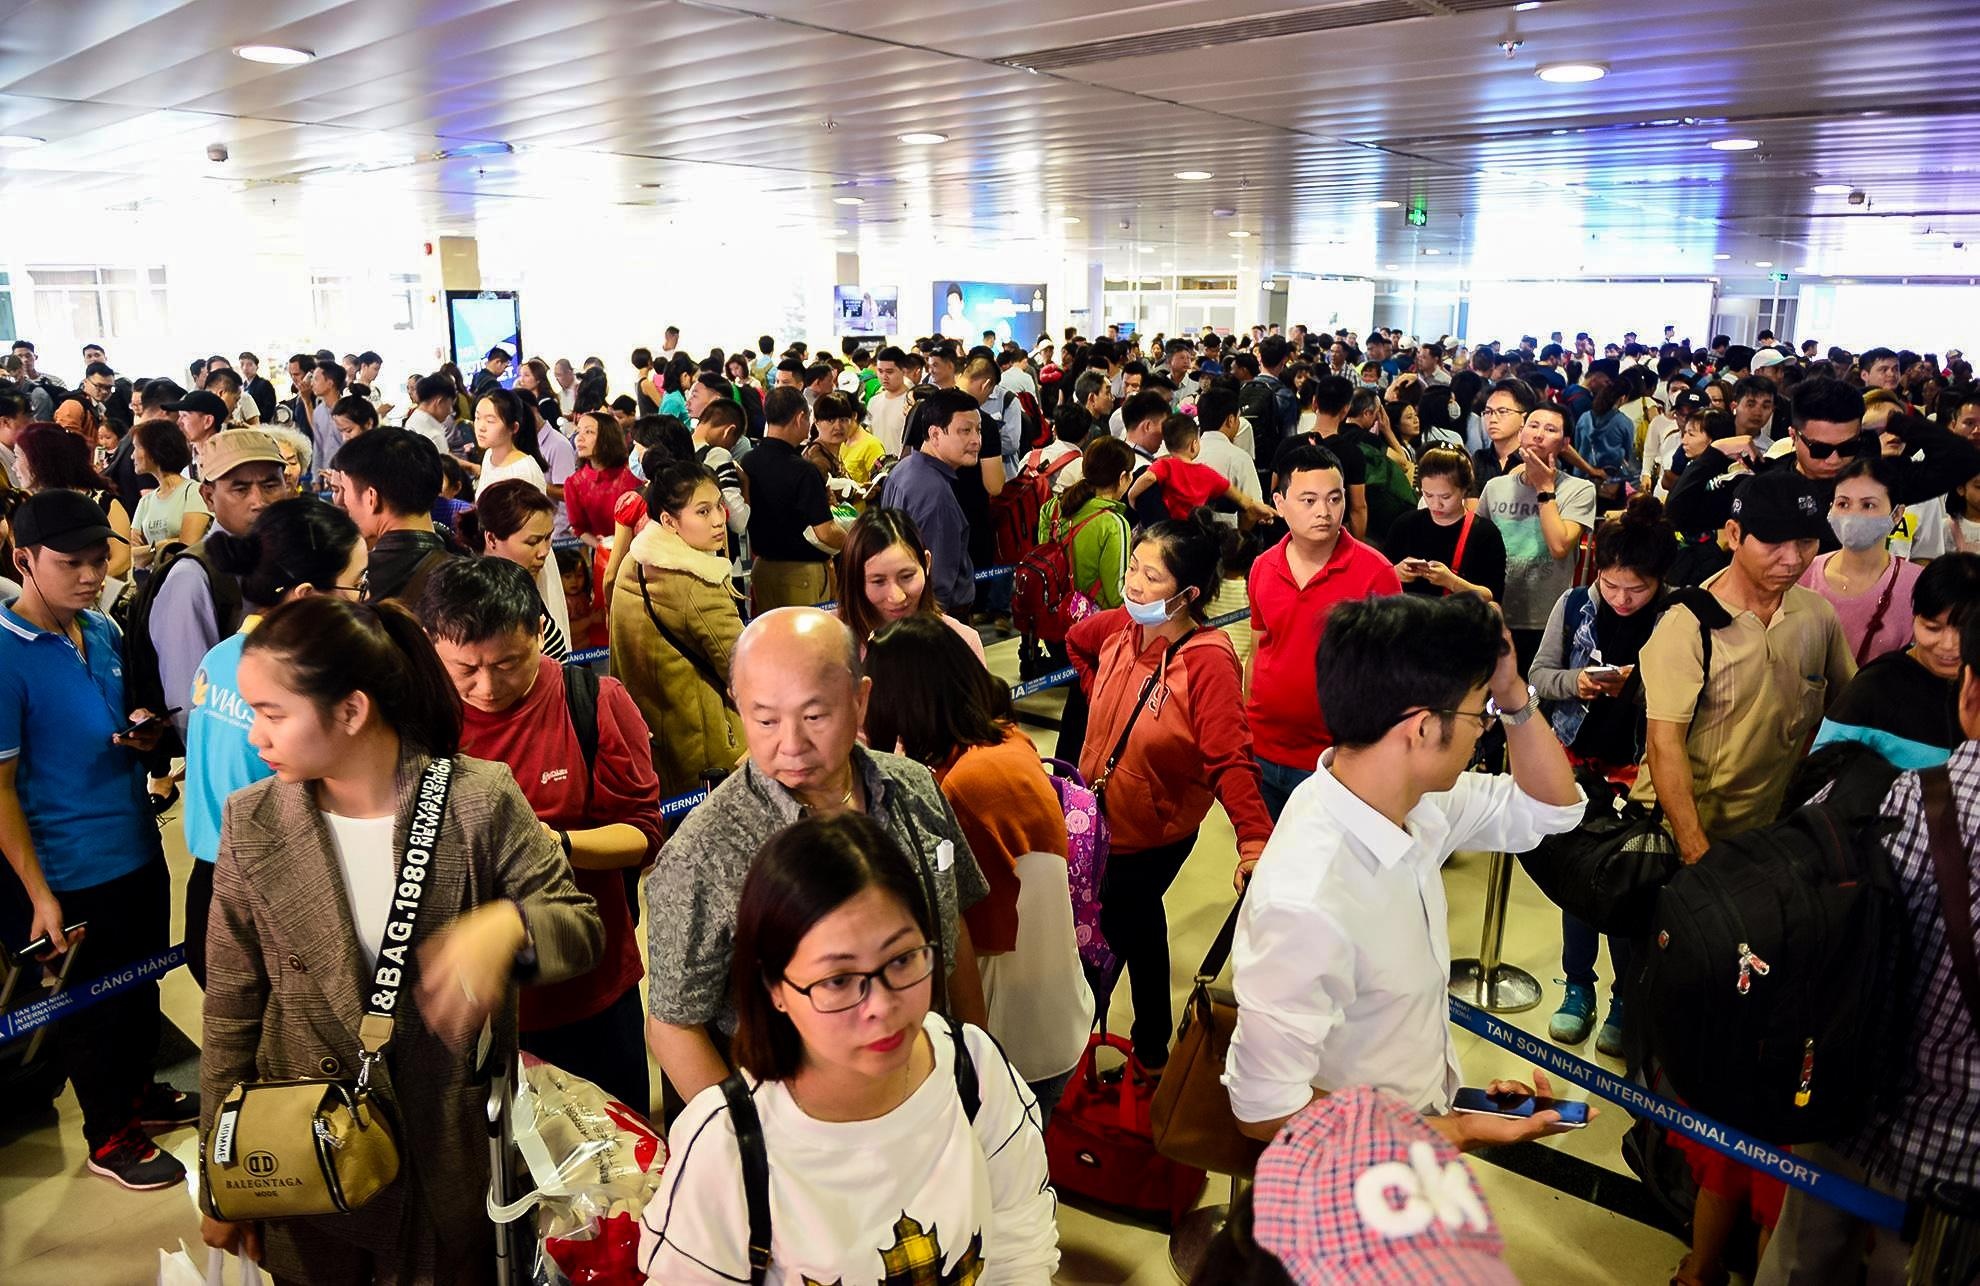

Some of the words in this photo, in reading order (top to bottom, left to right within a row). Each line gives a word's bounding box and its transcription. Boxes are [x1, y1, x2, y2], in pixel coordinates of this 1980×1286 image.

[1486, 1021, 1513, 1044] TAN
[1516, 1036, 1548, 1062] SON
[1551, 1055, 1593, 1082] NHAT
[1596, 1074, 1730, 1148] INTERNATIONAL
[1734, 1139, 1821, 1186] AIRPORT
[226, 1178, 303, 1189] BALEGNTAGA
